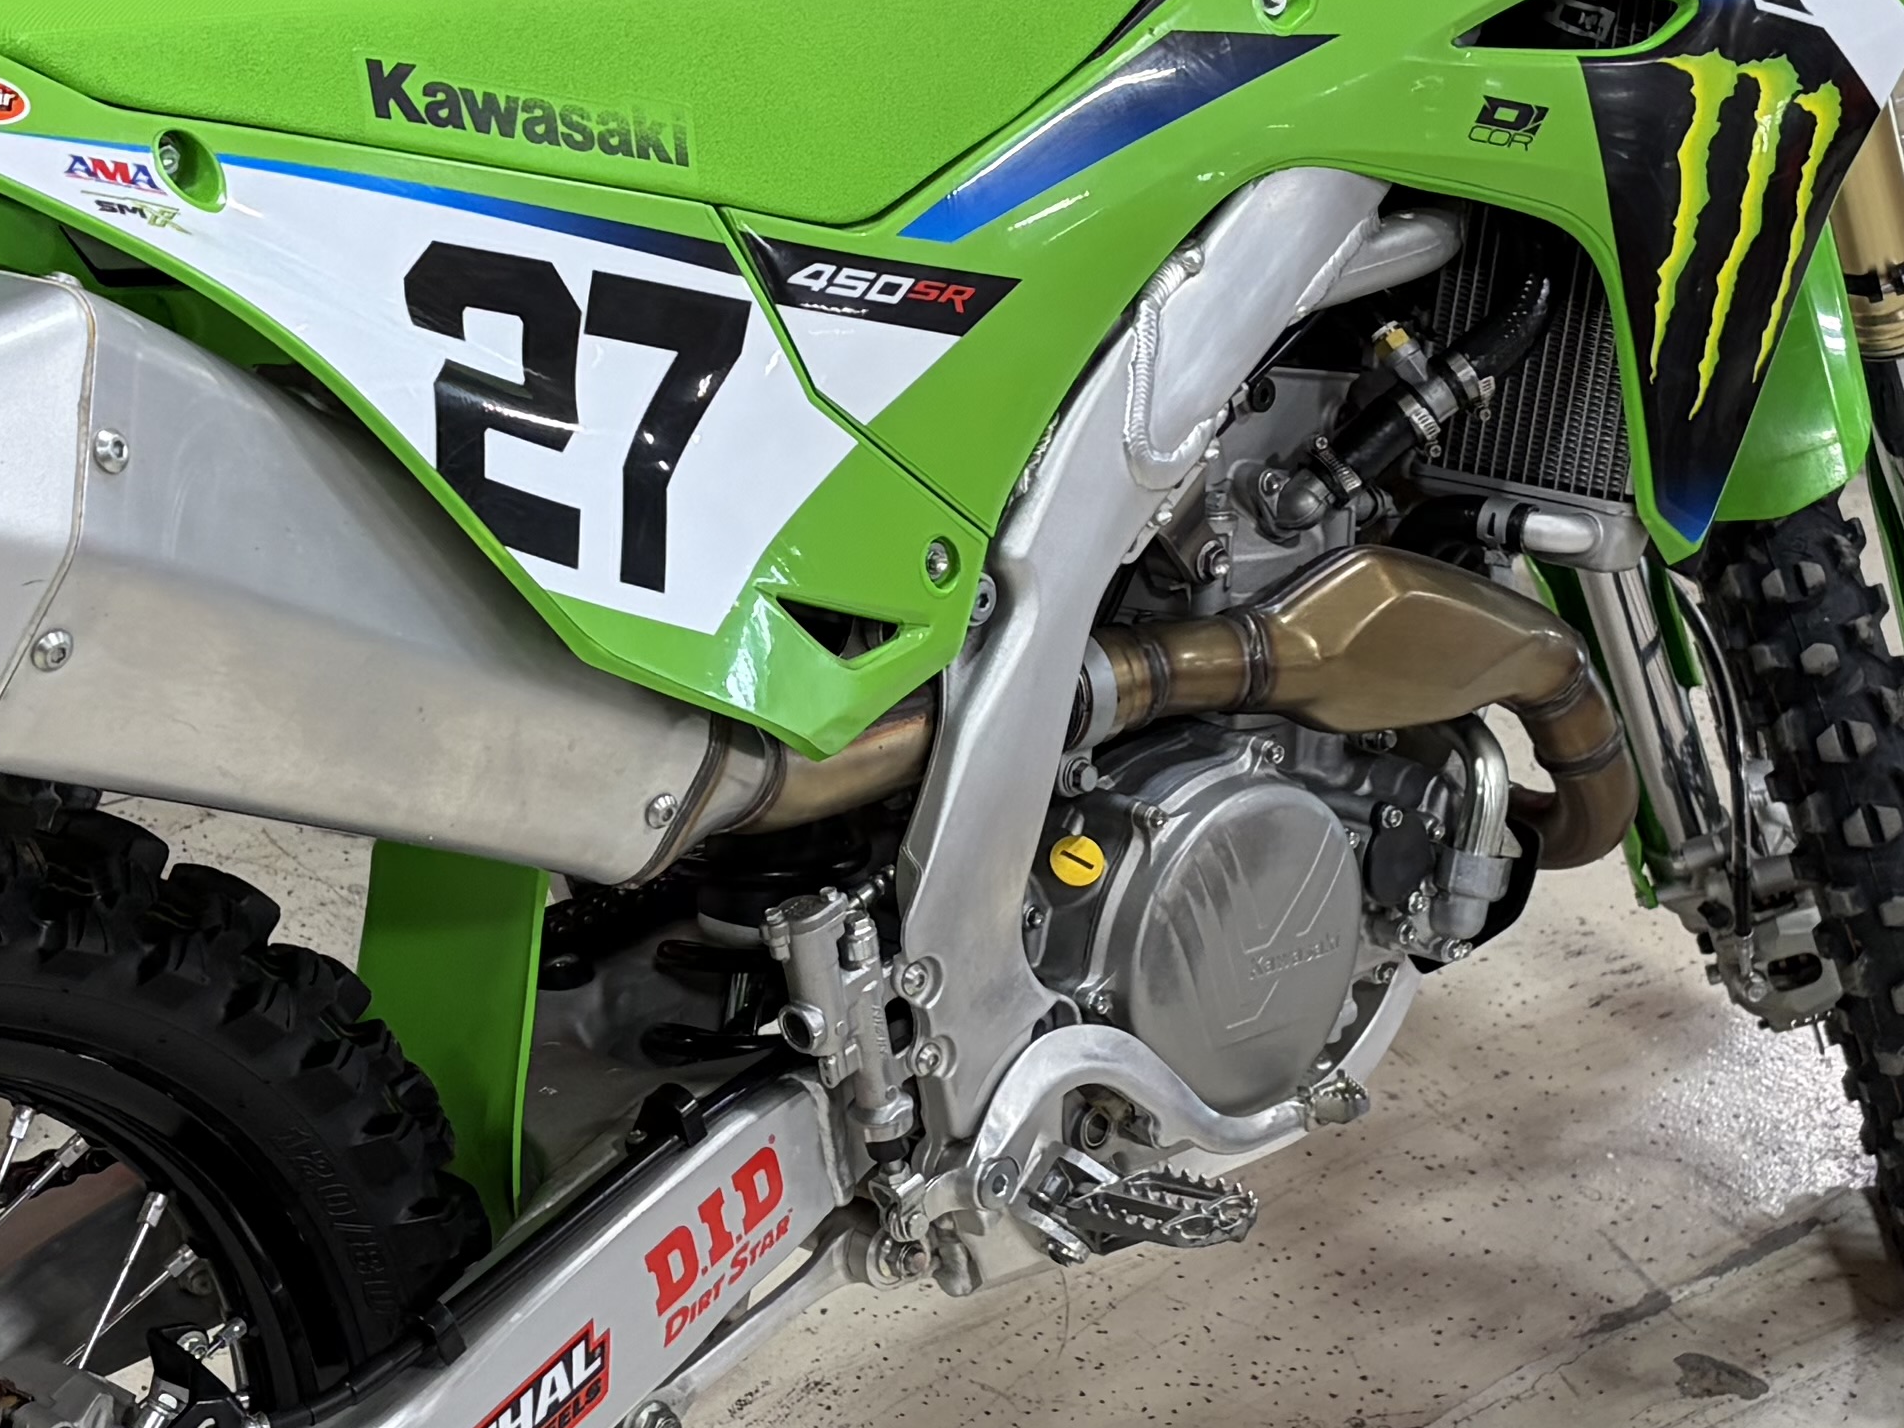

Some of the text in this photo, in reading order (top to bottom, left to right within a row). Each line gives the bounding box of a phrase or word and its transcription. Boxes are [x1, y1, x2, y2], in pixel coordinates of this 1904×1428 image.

[365, 57, 690, 168] Kawasaki
[64, 153, 162, 192] AMA
[786, 262, 977, 314] 450SR
[402, 240, 752, 593] 27
[643, 1142, 786, 1317] D.I.D
[663, 1286, 723, 1349] DIRT
